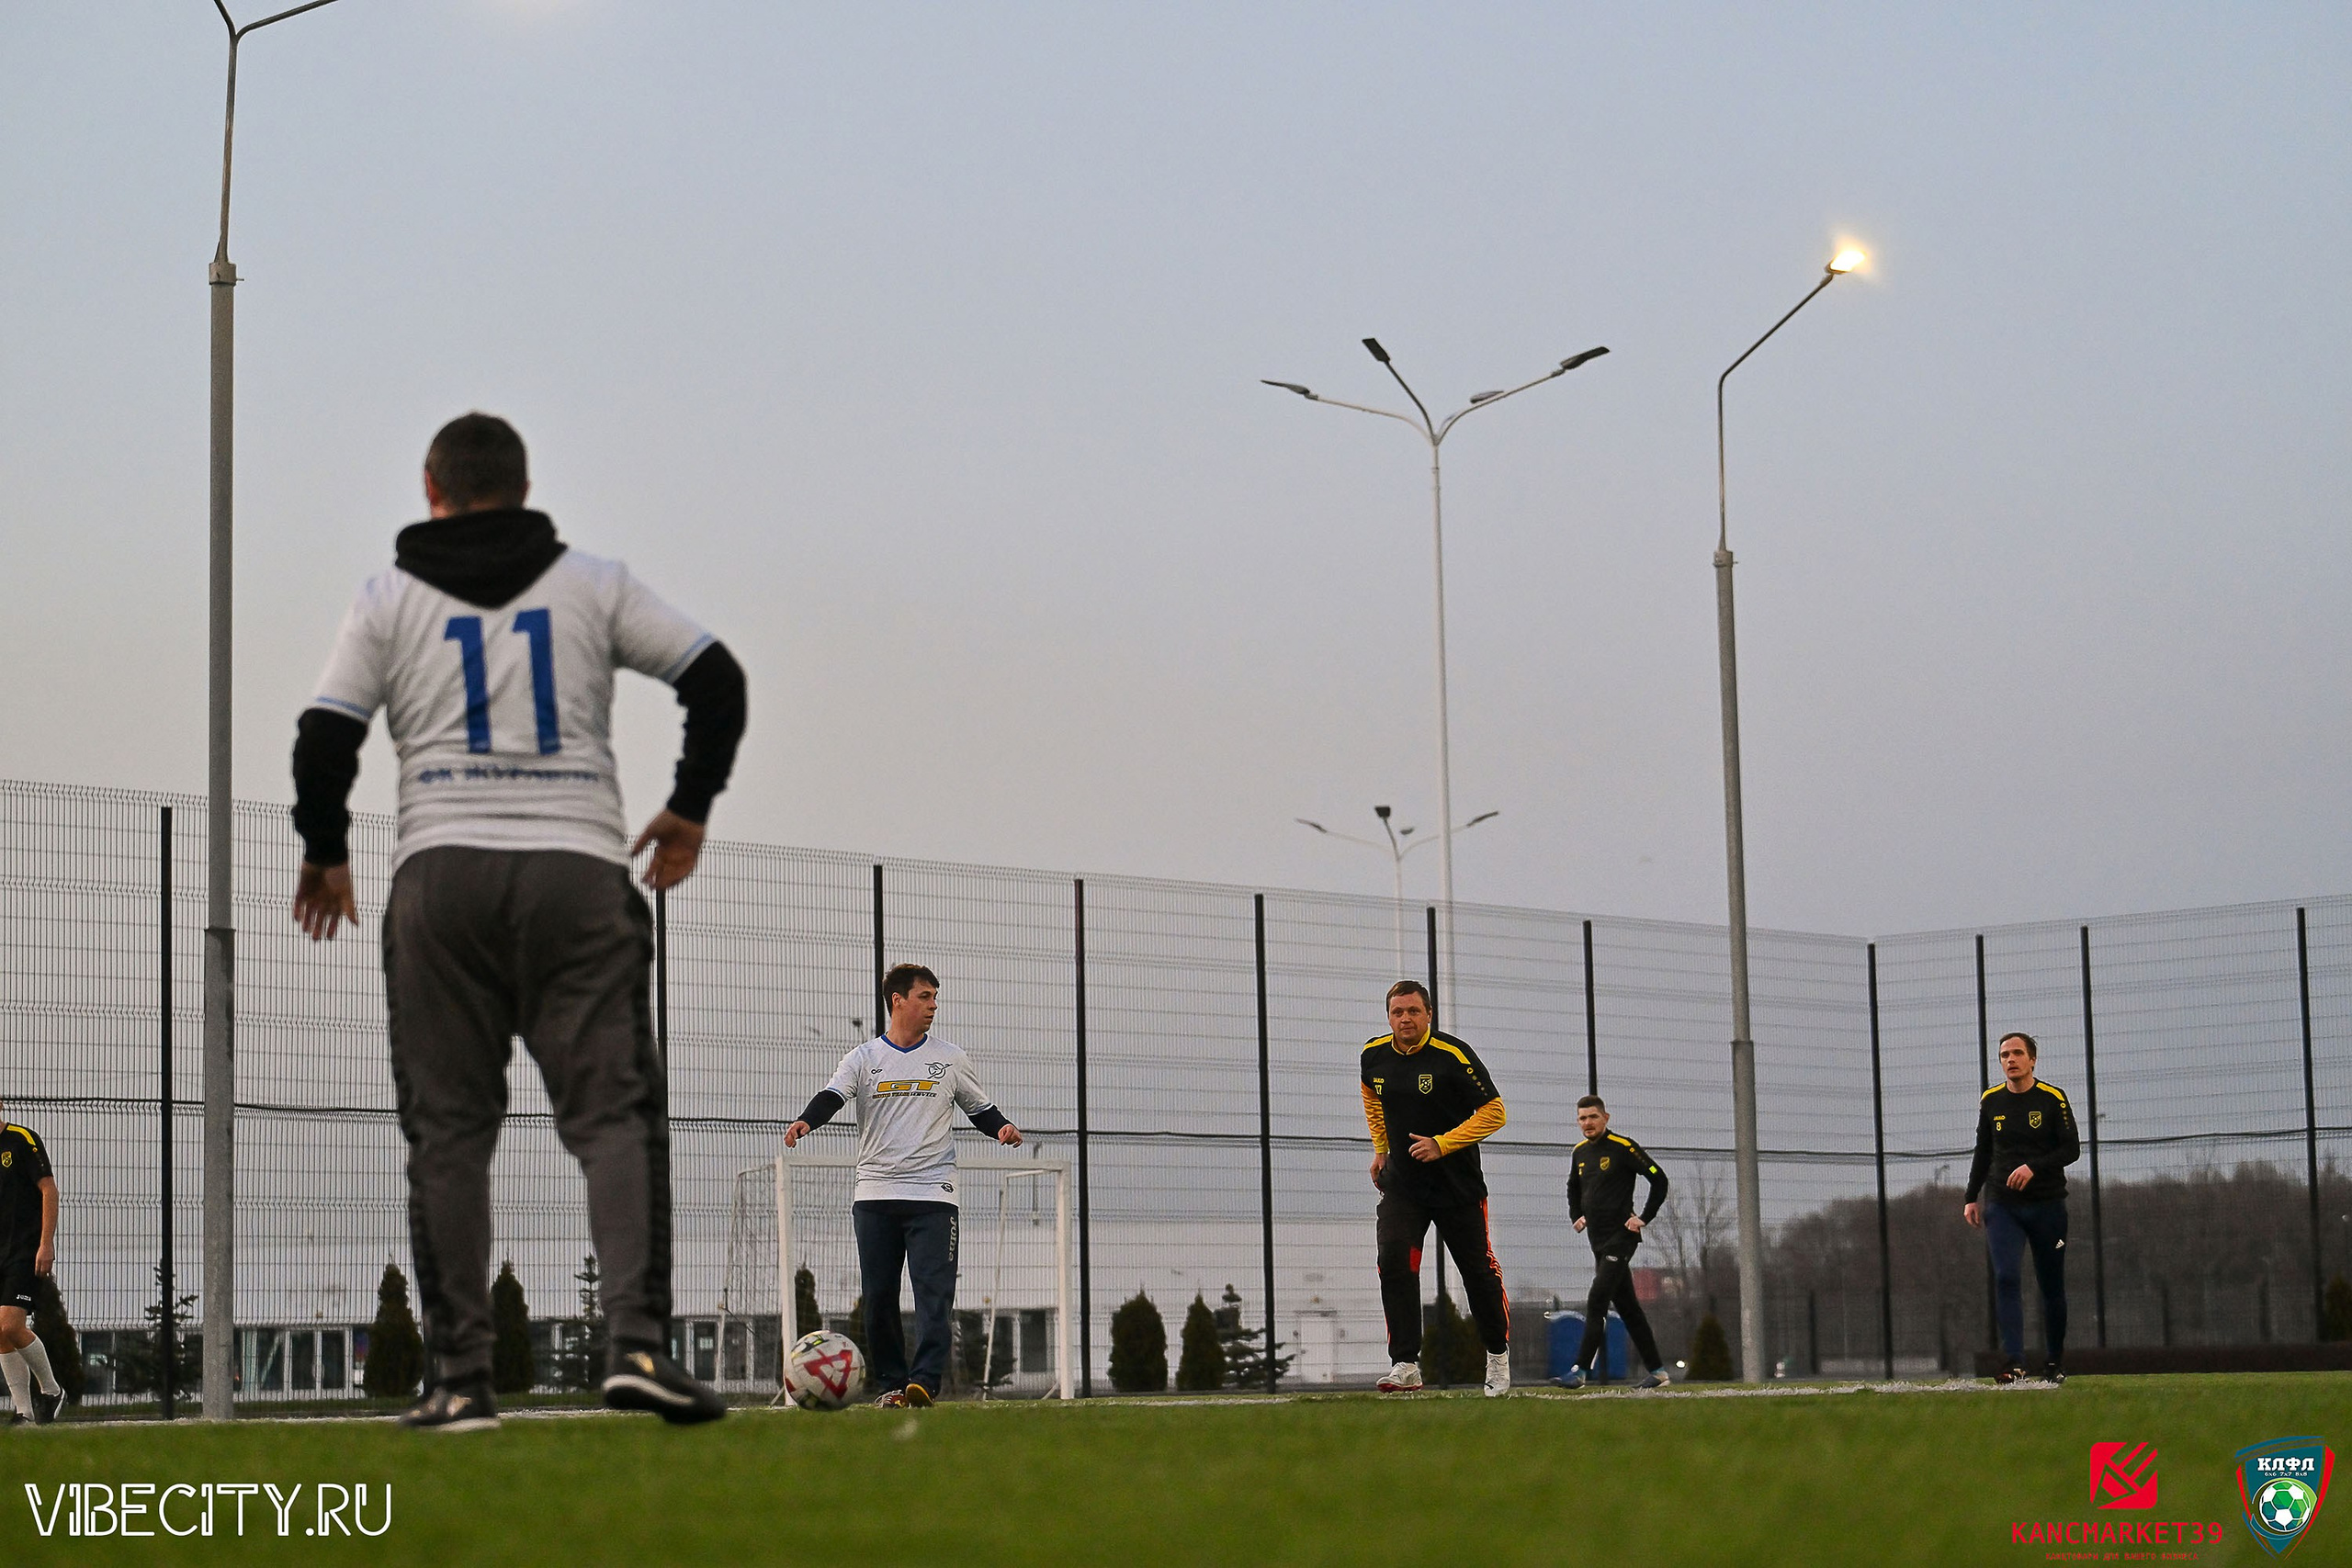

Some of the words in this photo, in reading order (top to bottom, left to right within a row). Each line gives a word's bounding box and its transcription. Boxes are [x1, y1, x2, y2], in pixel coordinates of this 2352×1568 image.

[443, 607, 562, 756] 11
[876, 1079, 940, 1092] GT
[1996, 1122, 2002, 1131] 8
